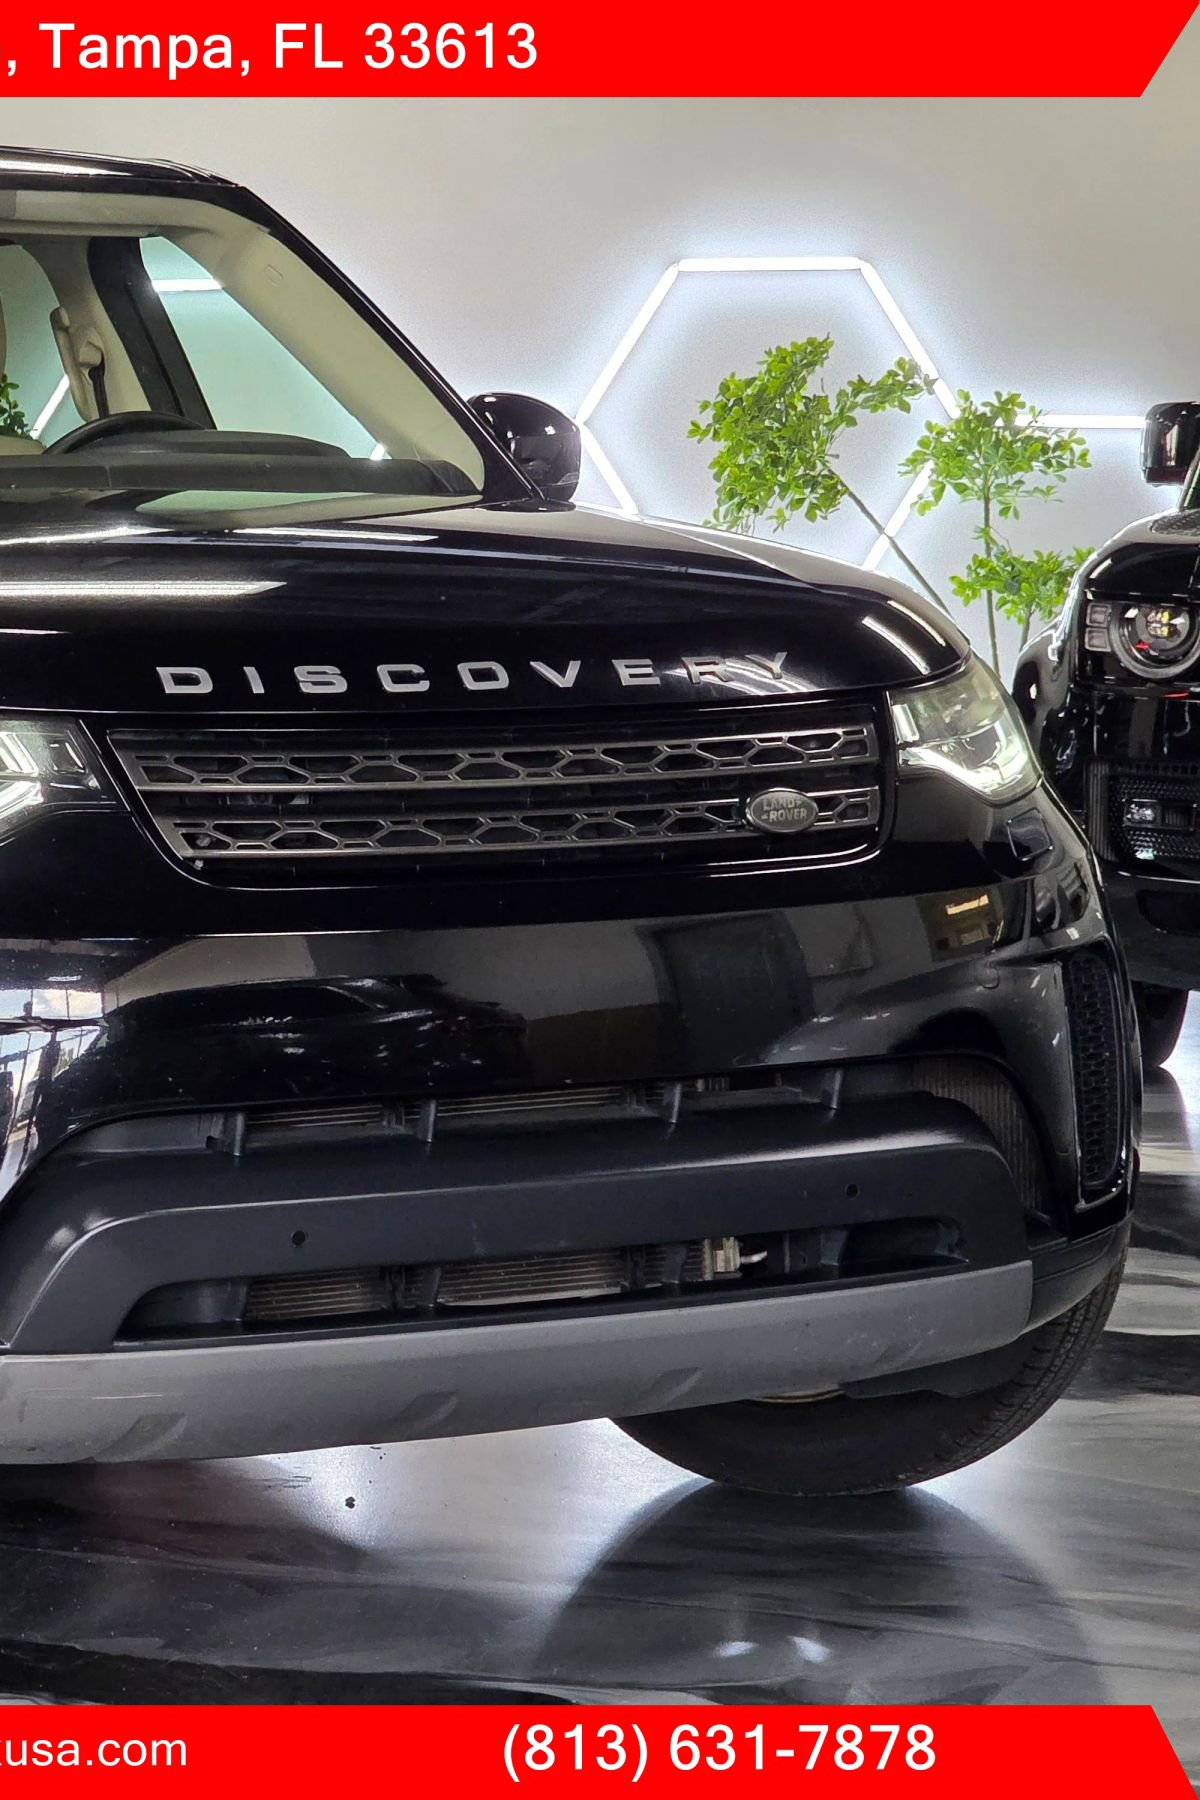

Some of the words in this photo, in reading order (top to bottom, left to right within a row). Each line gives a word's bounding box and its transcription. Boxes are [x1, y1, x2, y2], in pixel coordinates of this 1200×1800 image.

[156, 652, 788, 694] DISCOVERY
[762, 797, 796, 811] LAND
[769, 807, 808, 823] ROVER
